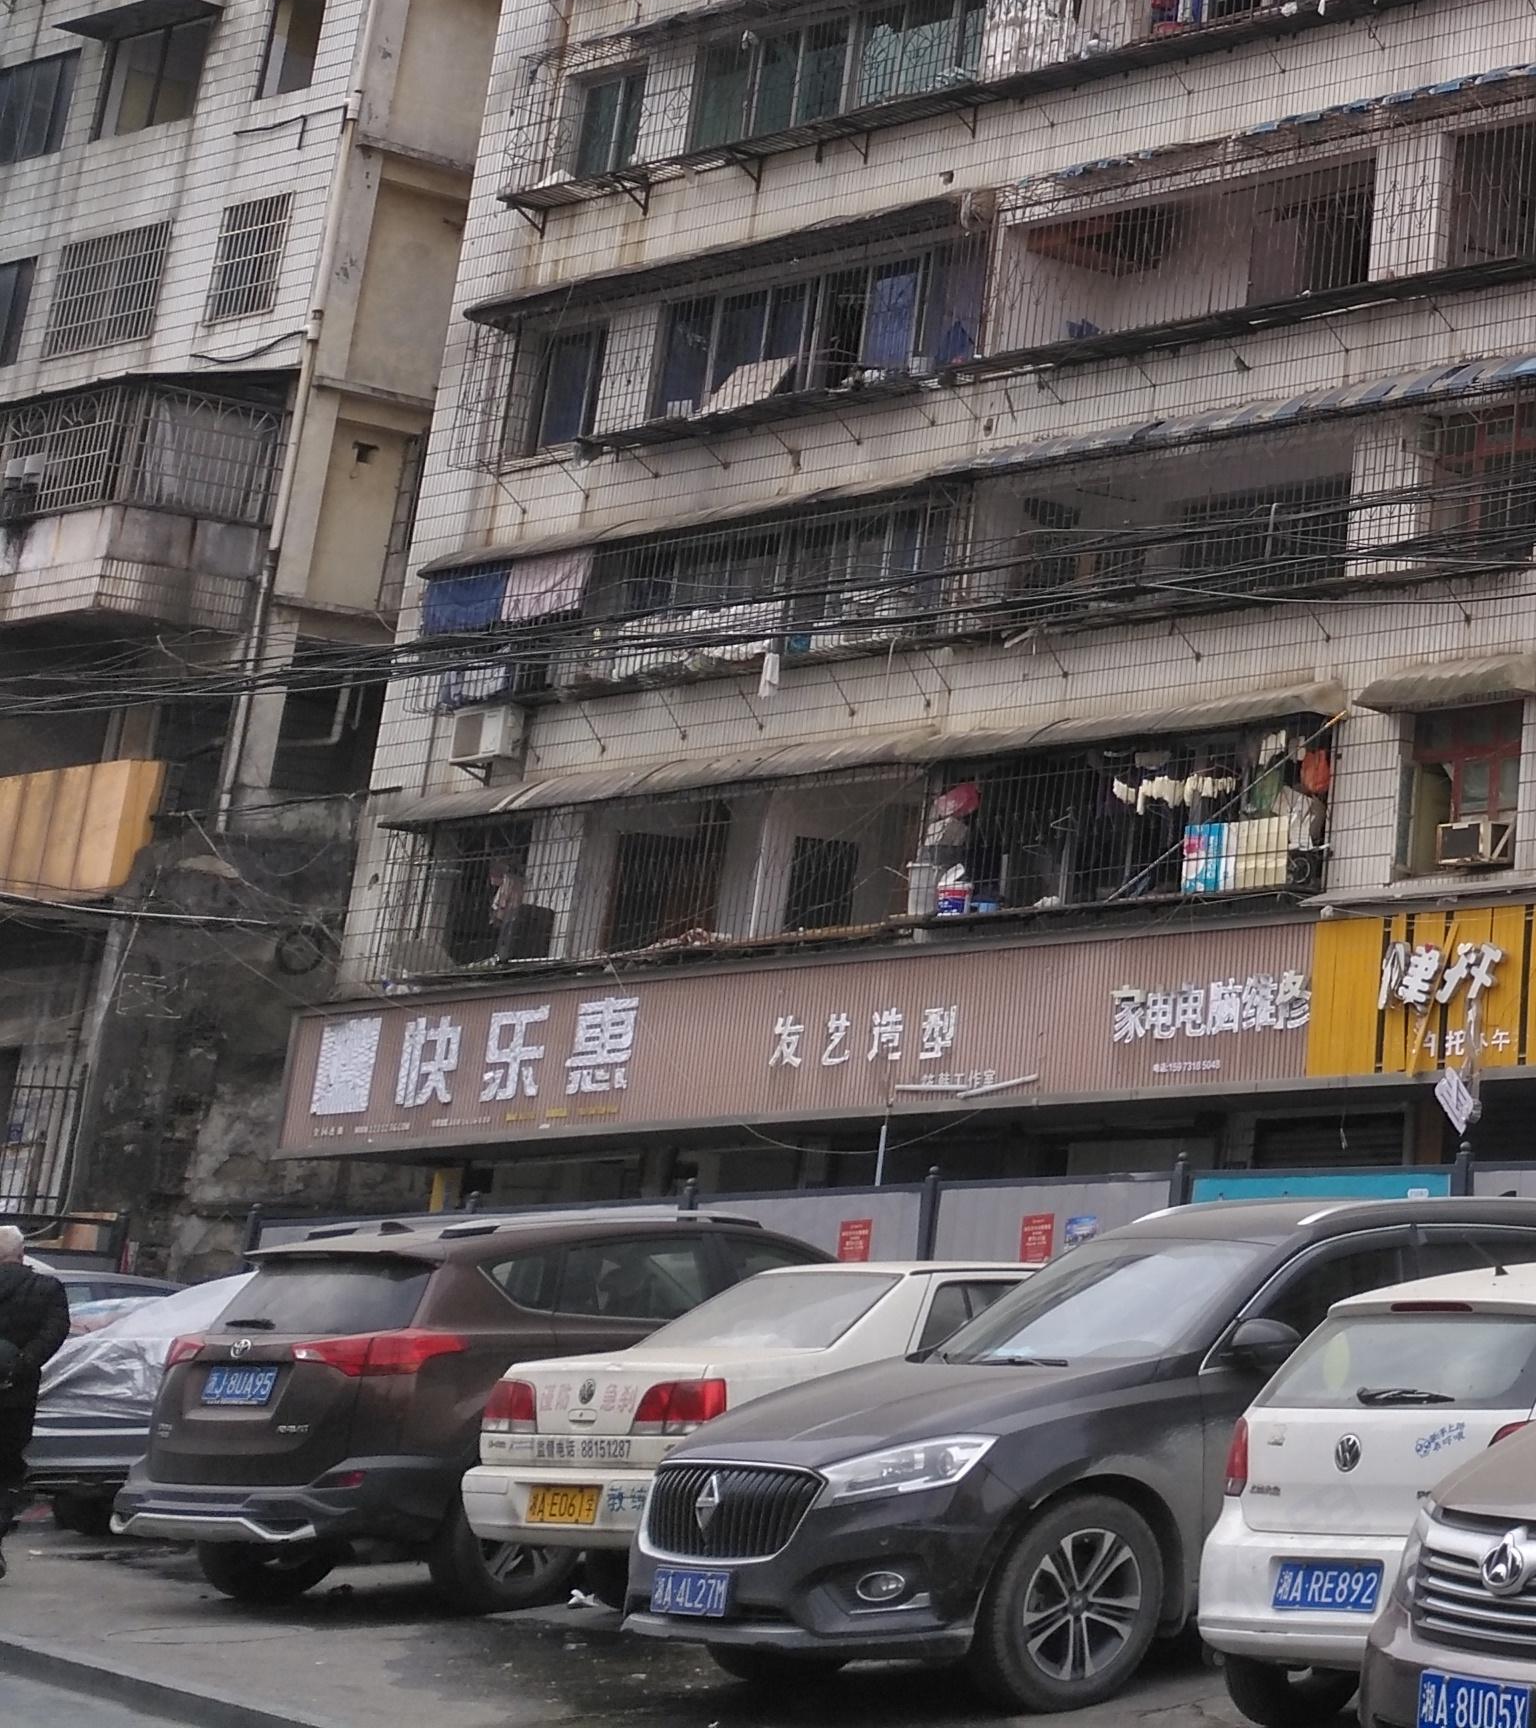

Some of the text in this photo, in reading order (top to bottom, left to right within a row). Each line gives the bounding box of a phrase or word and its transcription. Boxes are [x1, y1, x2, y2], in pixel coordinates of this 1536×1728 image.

[768, 1004, 958, 1069] 发艺造型
[1110, 969, 1313, 1045] 家电电脑维修
[395, 996, 640, 1109] 快乐惠
[536, 1440, 632, 1459] 监督电话 88151287
